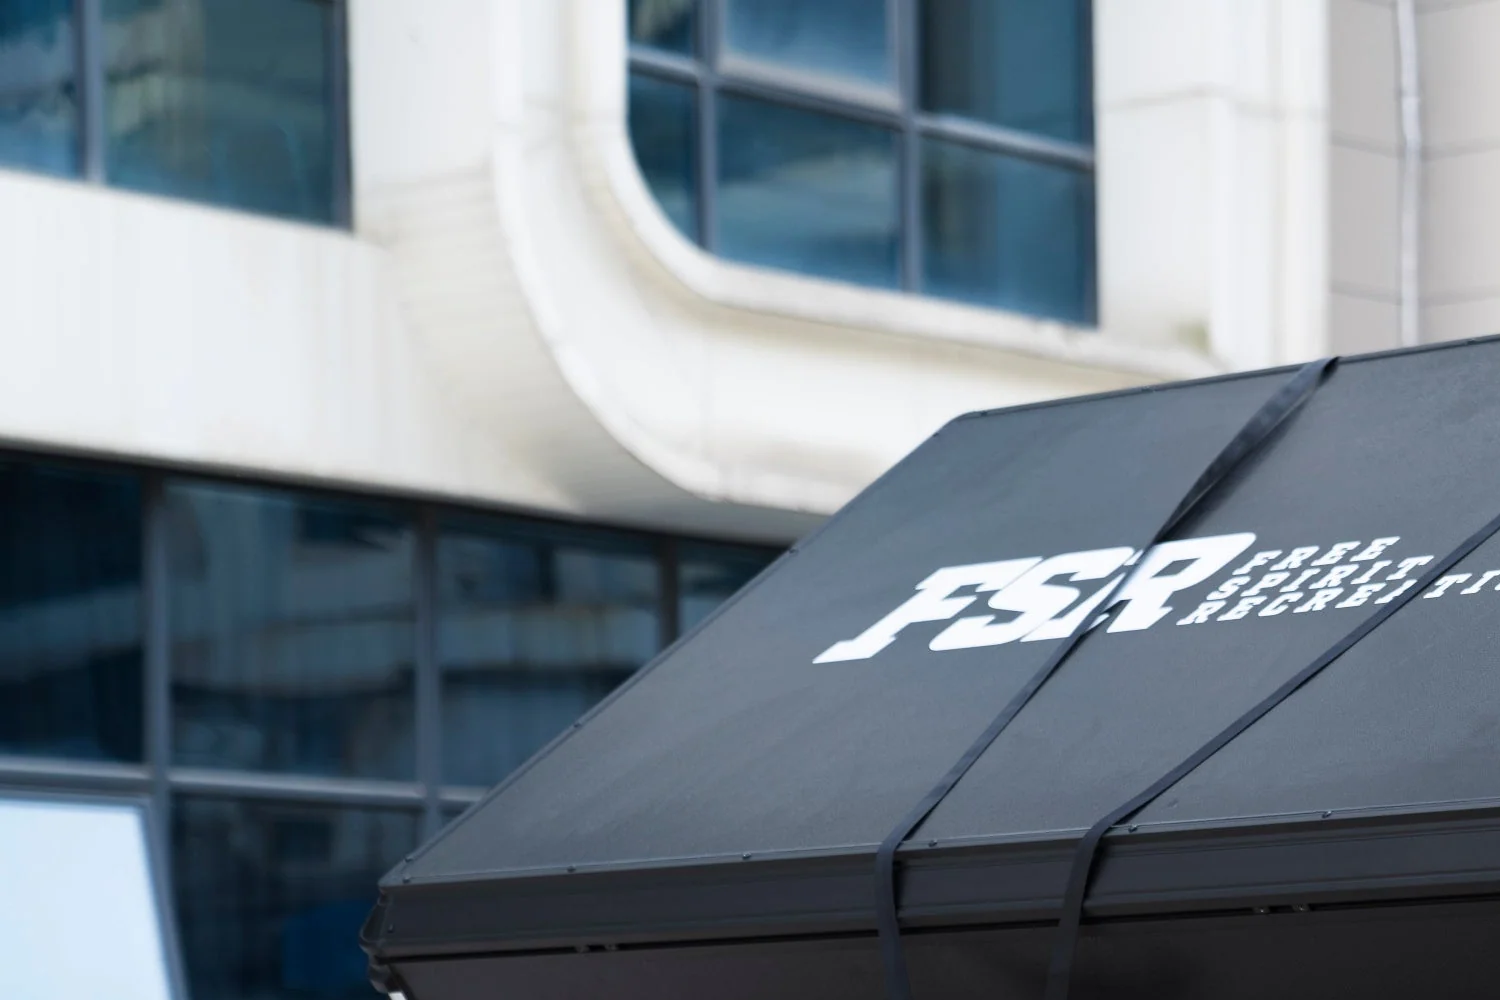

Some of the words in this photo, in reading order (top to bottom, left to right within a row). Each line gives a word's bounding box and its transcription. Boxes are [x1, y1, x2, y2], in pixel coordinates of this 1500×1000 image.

[1206, 555, 1434, 600] SPIRIT
[1232, 536, 1400, 576] FREE
[813, 532, 1257, 664] FSR
